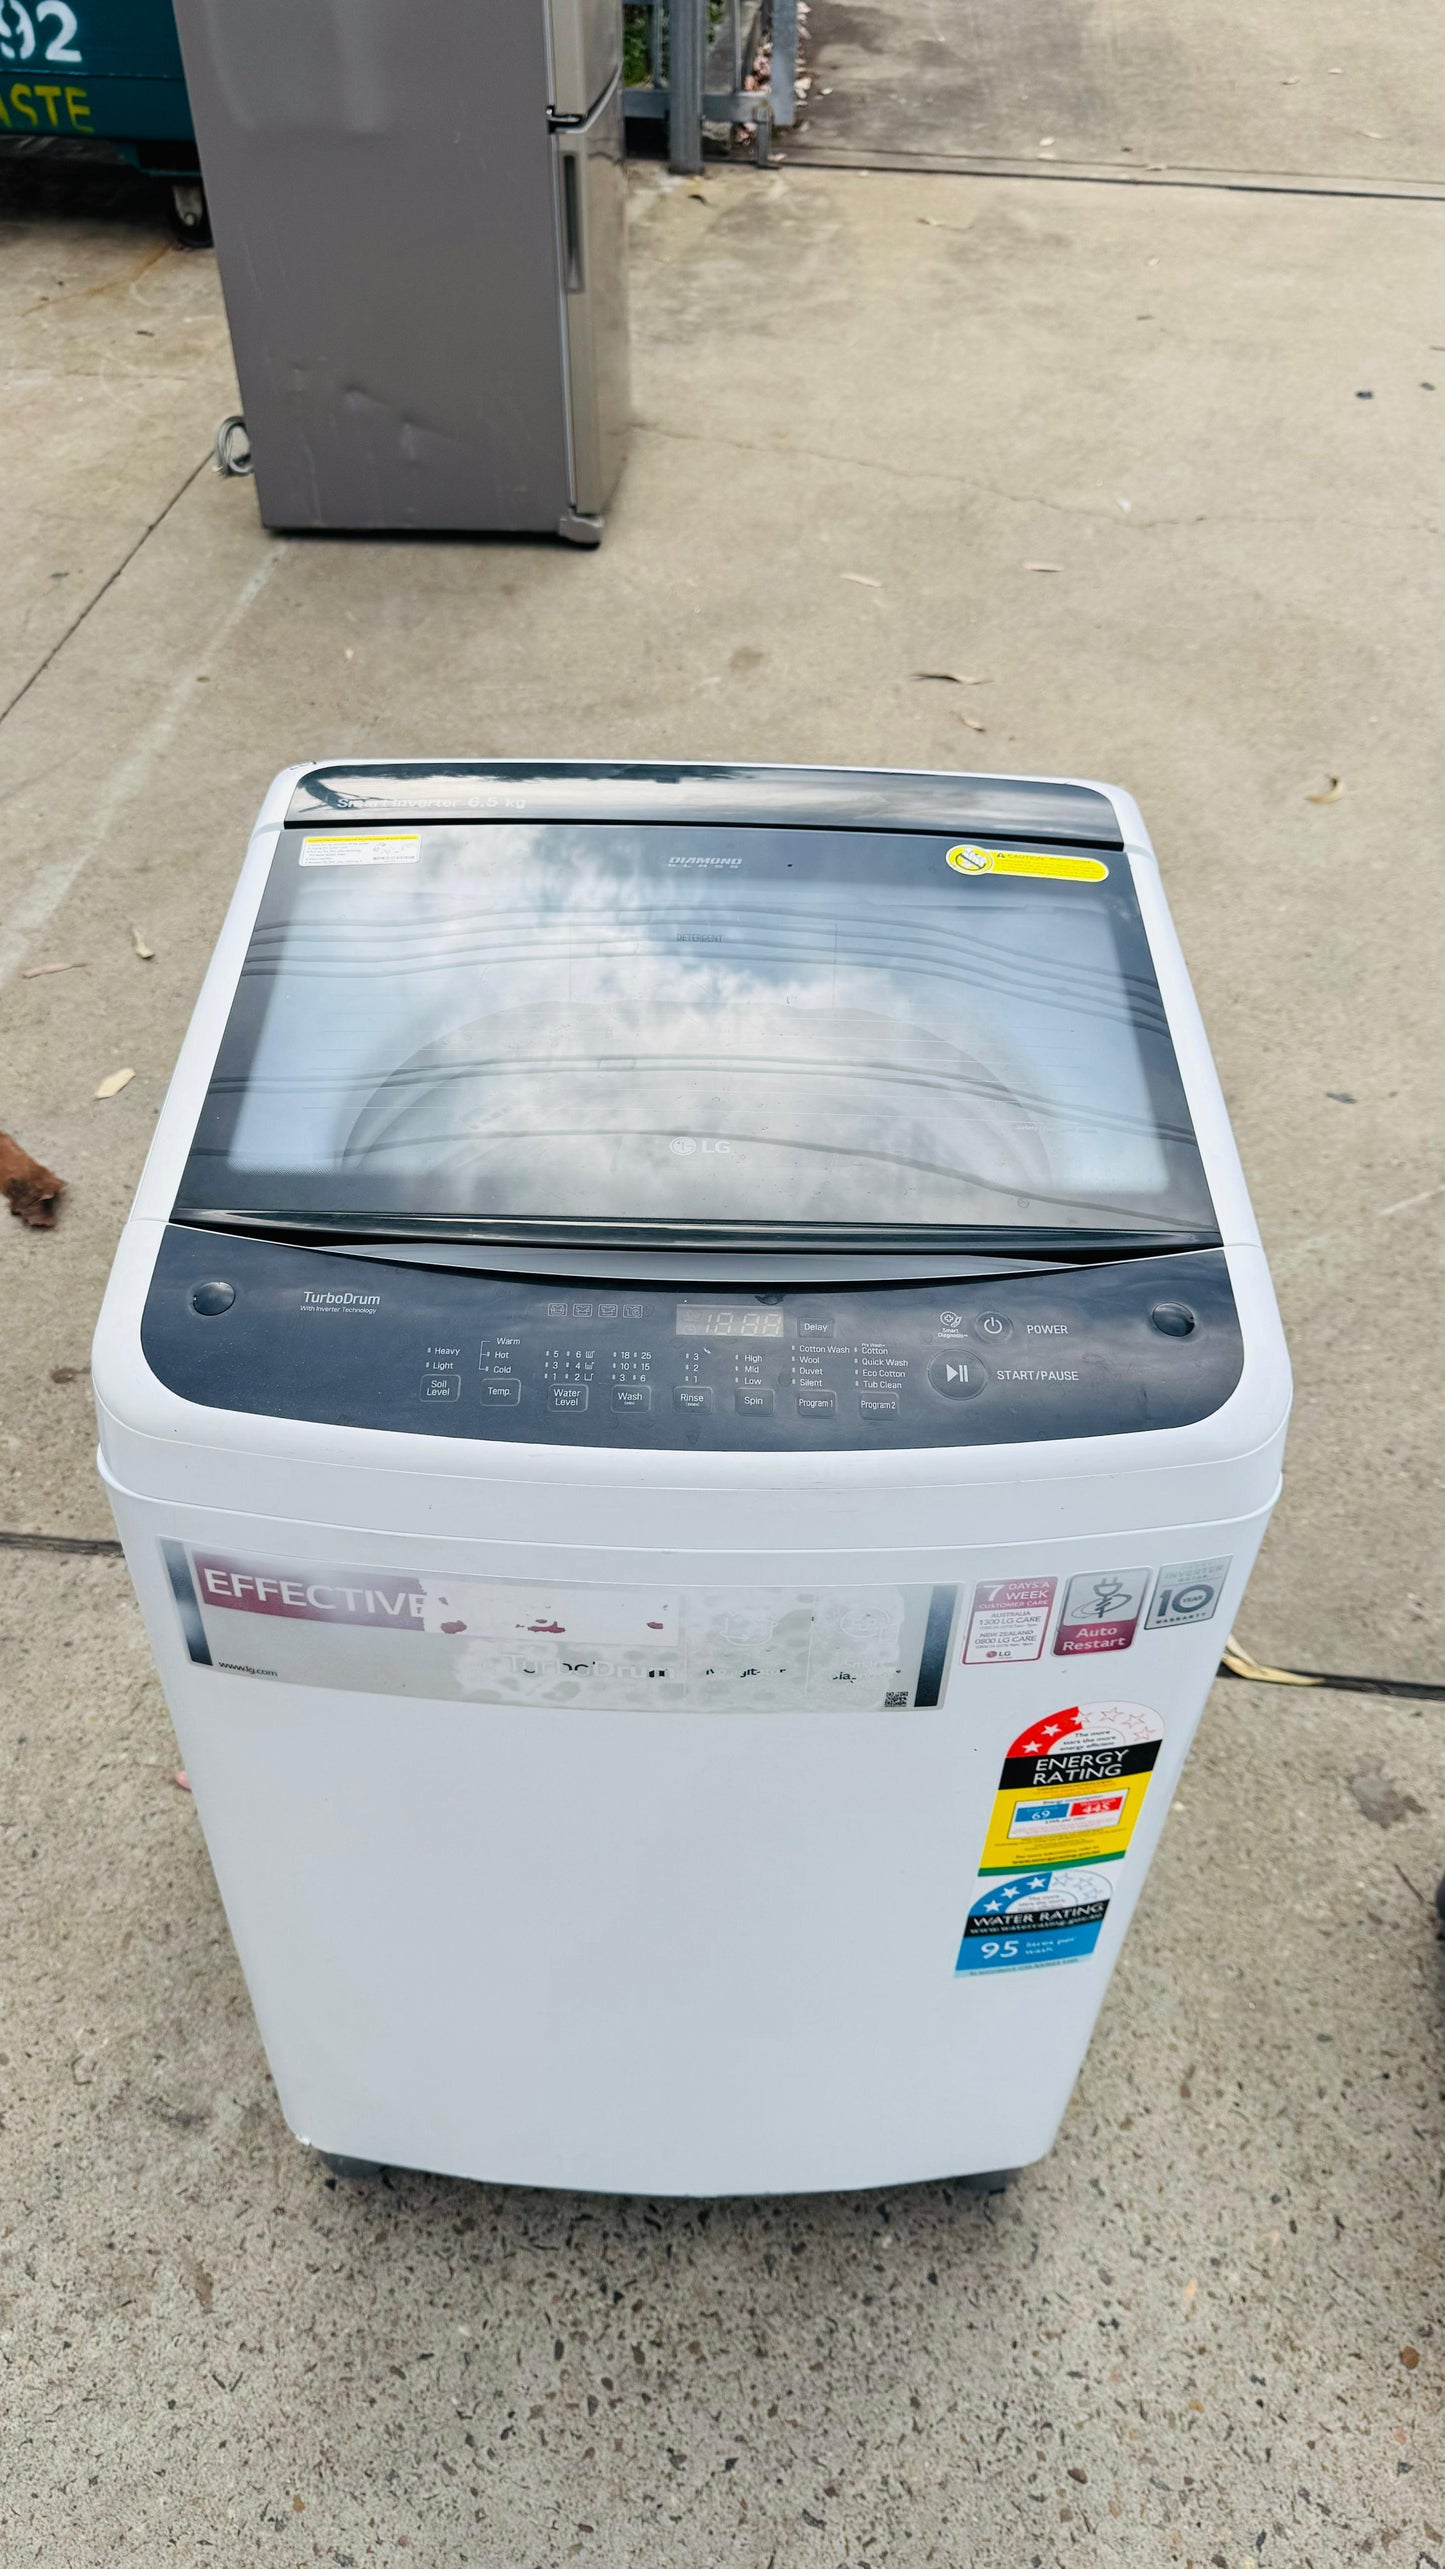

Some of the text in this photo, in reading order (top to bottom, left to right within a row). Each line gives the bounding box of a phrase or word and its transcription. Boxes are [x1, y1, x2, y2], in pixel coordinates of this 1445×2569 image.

[467, 797, 498, 808] 6.5
[506, 798, 526, 809] kg
[668, 856, 743, 865] DIAMOND
[701, 1140, 731, 1154] LG
[303, 1291, 381, 1305] TurboDrum
[316, 1305, 340, 1313] Inverter
[342, 1306, 377, 1315] Technology
[804, 1322, 828, 1332] Delay
[1027, 1324, 1068, 1335] POWER
[496, 1337, 520, 1345] Warm
[434, 1347, 460, 1356] Heavy
[799, 1344, 850, 1354] Cotton Wash
[861, 1347, 888, 1355] Cotton
[494, 1351, 509, 1359] Hot
[553, 1350, 582, 1358] 5 6
[620, 1351, 652, 1360] 18 25
[693, 1352, 699, 1361] 3
[744, 1354, 763, 1364] High
[799, 1356, 820, 1364] Wool
[861, 1358, 909, 1367] Quick Wash
[433, 1362, 453, 1371] Light
[493, 1366, 511, 1374] Cold
[552, 1361, 581, 1370] 3 4
[620, 1363, 651, 1371] 10 15
[693, 1364, 699, 1372] 2
[744, 1365, 759, 1373] Mid
[800, 1367, 823, 1376] Duvet
[863, 1369, 906, 1378] Eco Cotton
[997, 1370, 1079, 1381] START/PAUSE
[574, 1373, 581, 1382] 2
[619, 1374, 646, 1382] 3 6
[744, 1377, 762, 1385] Low
[431, 1380, 447, 1388] Soil
[800, 1379, 823, 1387] Silent
[864, 1380, 902, 1389] Tub Clean
[426, 1388, 450, 1396] Level
[488, 1387, 512, 1397] Temp.
[553, 1389, 581, 1398] Water
[617, 1392, 643, 1401] Wash
[555, 1398, 578, 1406] Level
[680, 1393, 704, 1402] Rinse
[744, 1396, 763, 1406] Spin
[799, 1399, 829, 1409] Program
[860, 1400, 891, 1410] Program
[1008, 1582, 1037, 1590] DAYS
[983, 1584, 1005, 1602] 7
[1006, 1590, 1048, 1600] WEEK
[979, 1601, 1025, 1609] CUSTOMER
[1157, 1584, 1215, 1617] 10
[1076, 1627, 1118, 1638] Auto
[1063, 1637, 1127, 1651] Restart
[218, 1662, 278, 1676] www.lg.com
[1035, 1749, 1129, 1772] ENERGY
[1032, 1764, 1122, 1785] RATING
[1031, 1810, 1051, 1820] 69
[973, 1913, 1034, 1927] WATER
[1039, 1902, 1105, 1921] RATING
[981, 1940, 1020, 1960] 95
